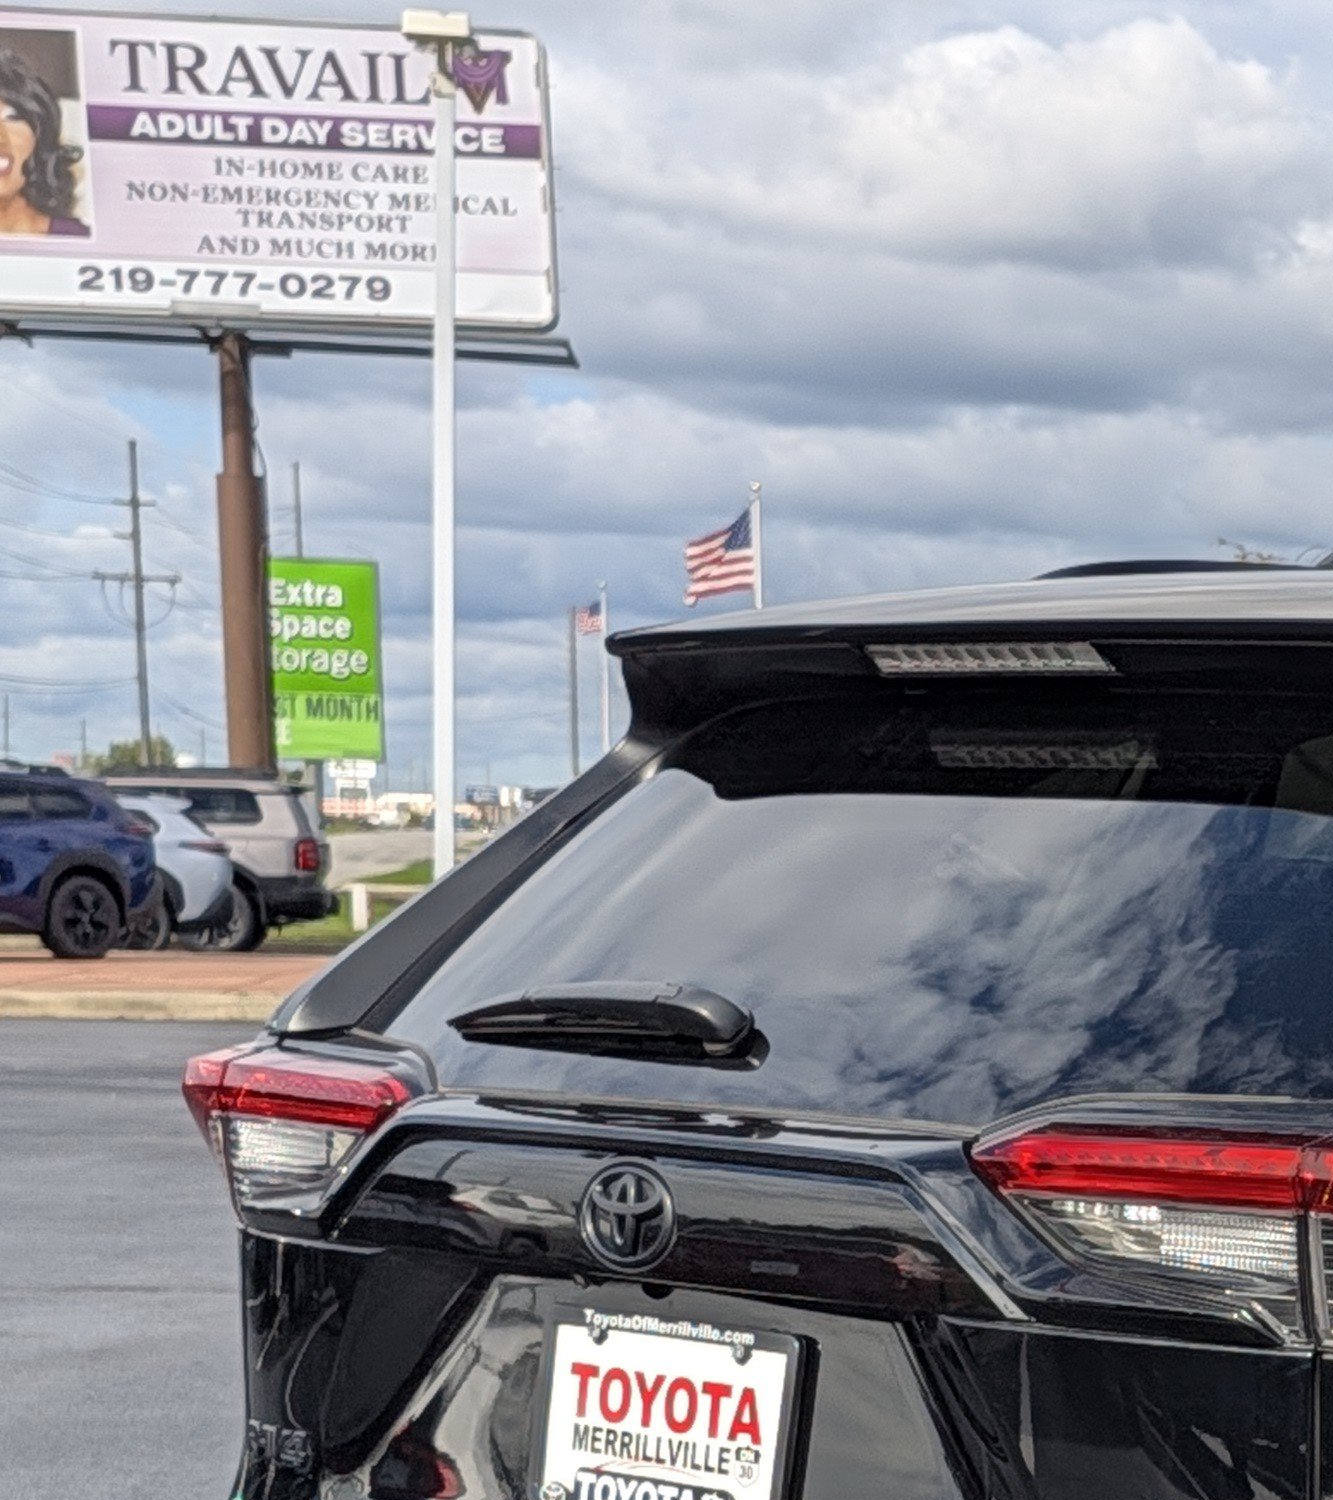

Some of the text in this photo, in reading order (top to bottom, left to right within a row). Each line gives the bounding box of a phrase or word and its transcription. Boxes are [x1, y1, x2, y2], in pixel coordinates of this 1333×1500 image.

[129, 110, 506, 154] ADULT DAY SERVCE
[214, 155, 430, 184] IN-HOME CARE
[125, 179, 518, 217] NON-EMERGENCY MEICAL
[235, 207, 413, 234] TRANSPORT
[196, 234, 260, 256] AND
[268, 237, 355, 260] MUCH
[77, 265, 392, 302] 219-777-0279
[268, 576, 344, 608] Extra
[272, 645, 369, 680] torage
[306, 694, 380, 722] MONTH
[571, 1361, 762, 1446] TOYOTA
[571, 1422, 732, 1476] MERRILLVILLE
